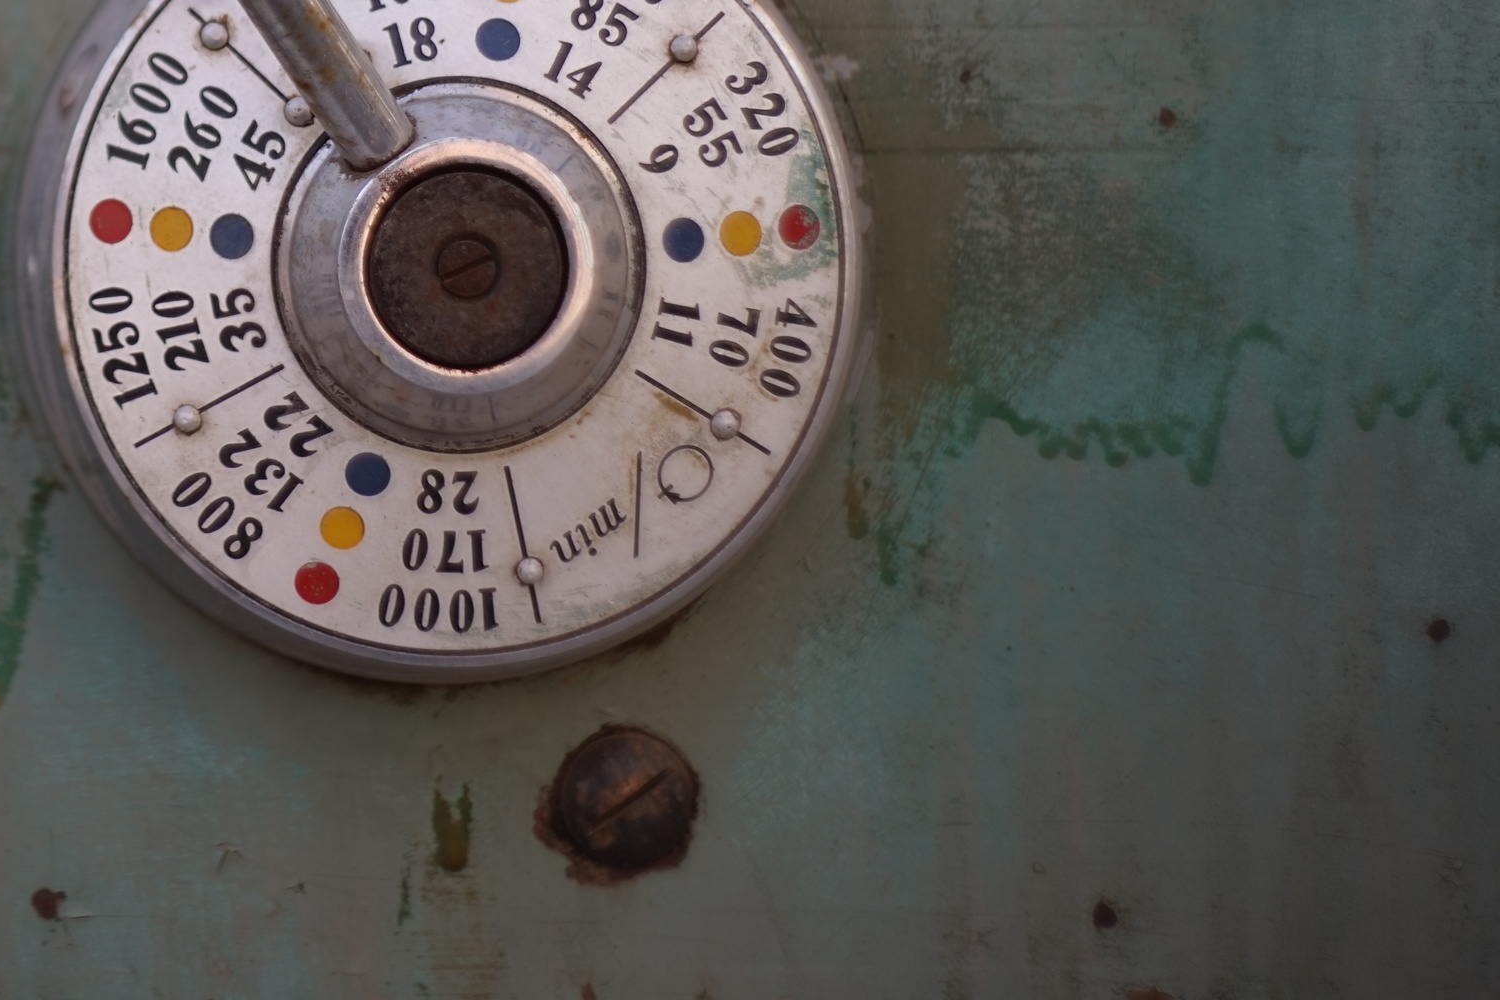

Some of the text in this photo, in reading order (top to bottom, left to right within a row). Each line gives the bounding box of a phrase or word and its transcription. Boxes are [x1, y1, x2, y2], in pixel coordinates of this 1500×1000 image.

[382, 17, 438, 69] 18
[543, 40, 602, 99] 14
[106, 52, 188, 171] 1600
[167, 86, 238, 182] 260
[682, 97, 743, 168] 55
[725, 61, 799, 156] 320
[233, 119, 286, 192] 45
[88, 287, 158, 410] 1250
[151, 291, 210, 371] 210
[209, 287, 267, 352] 35
[651, 297, 700, 347] 11
[708, 307, 761, 367] 70
[759, 297, 818, 398] 400
[263, 391, 334, 458] 22
[218, 428, 304, 513] 132
[416, 468, 480, 515] 28
[171, 472, 263, 559] 800
[402, 527, 490, 573] 170
[378, 583, 499, 634] 1000
